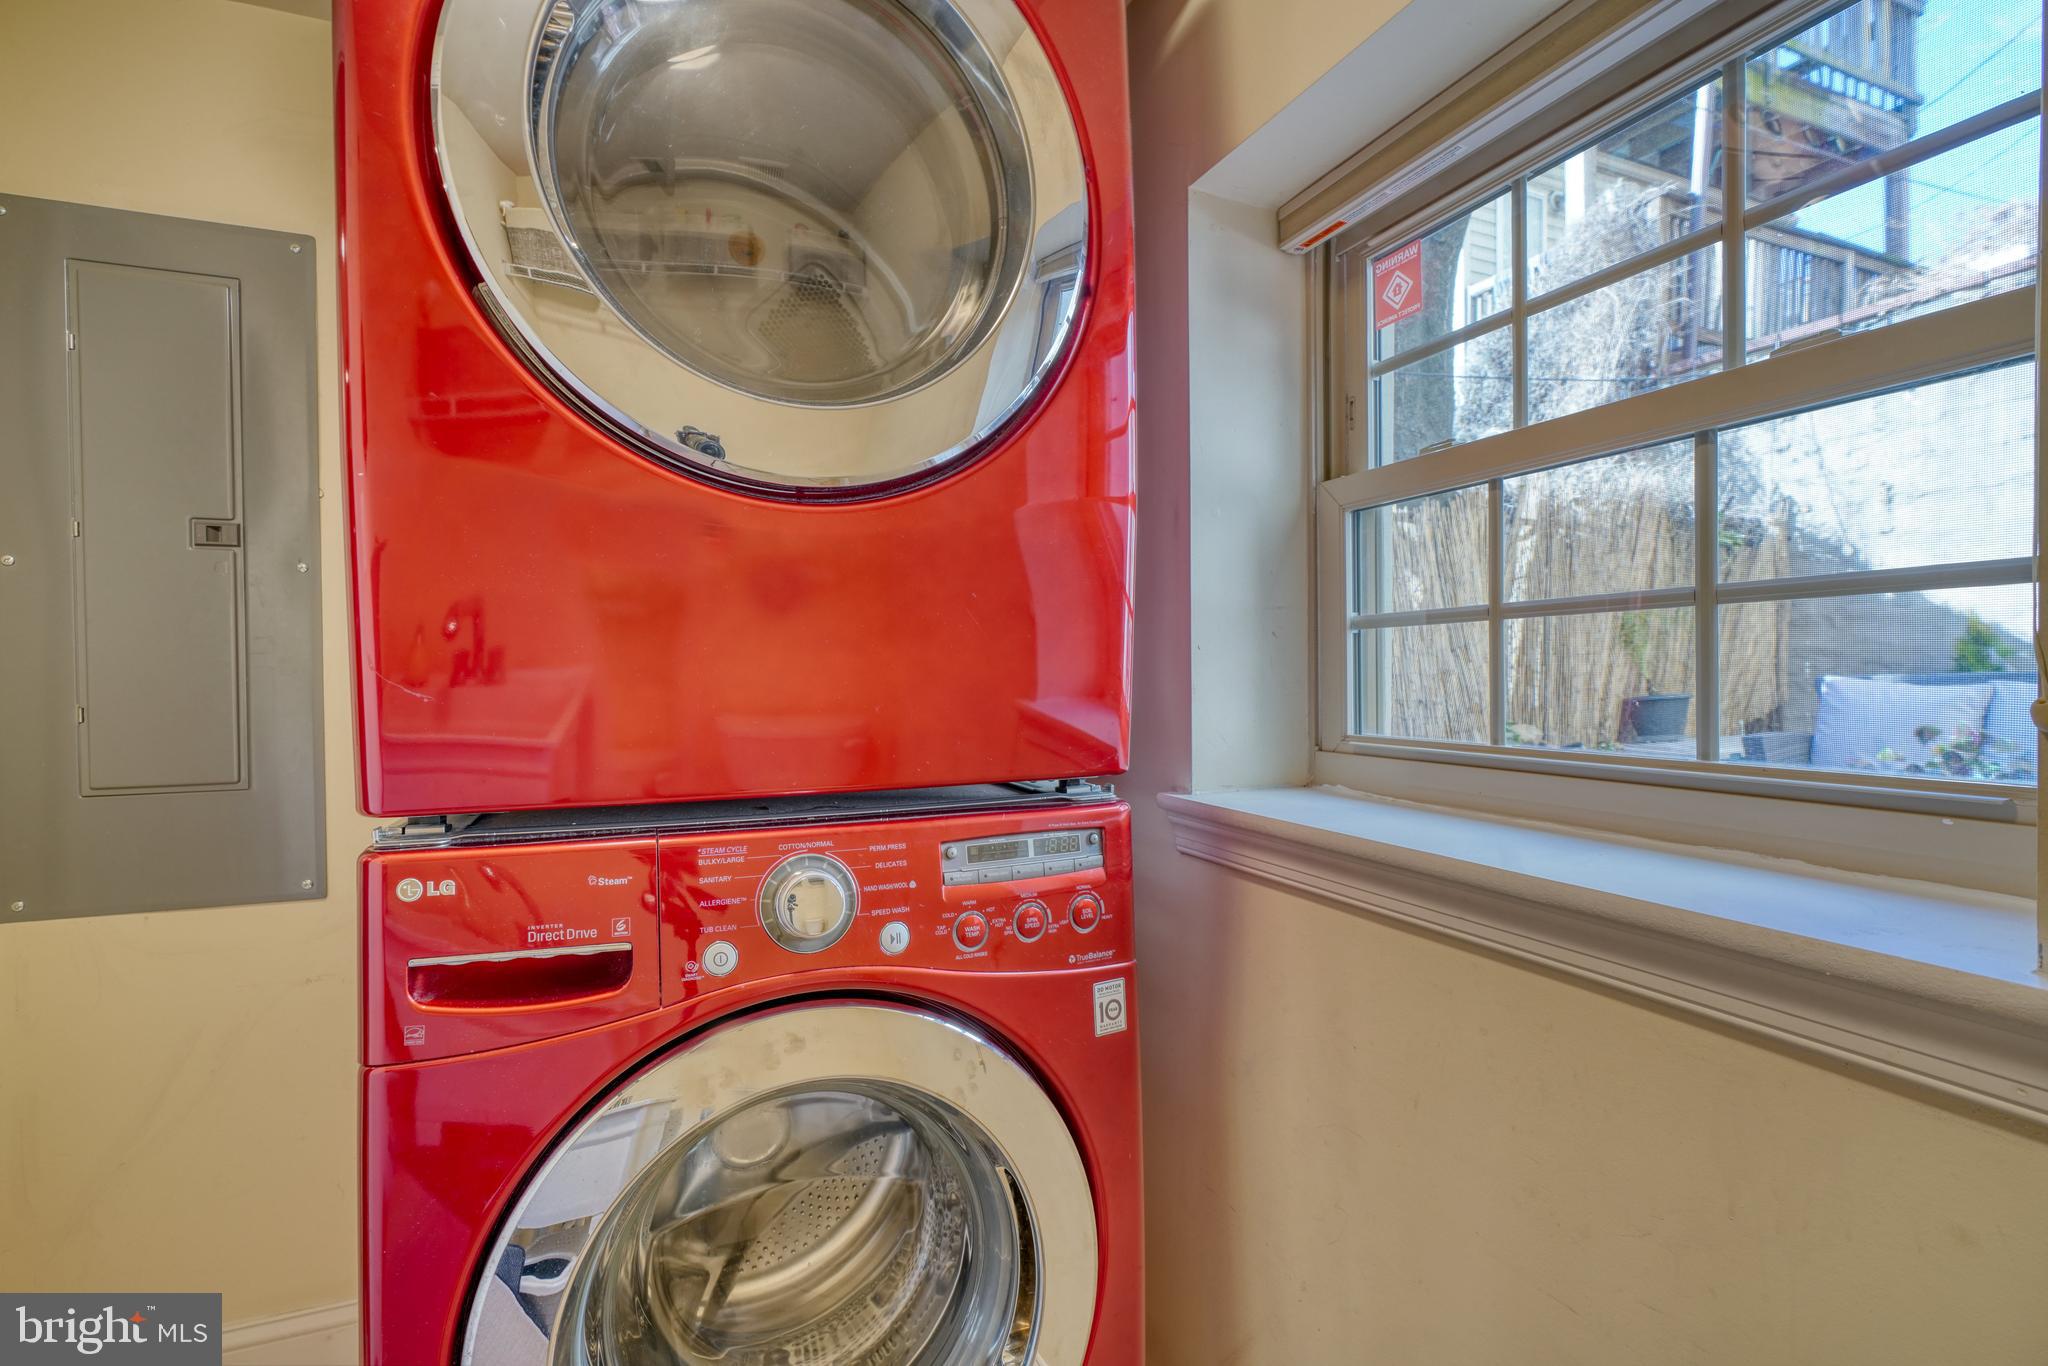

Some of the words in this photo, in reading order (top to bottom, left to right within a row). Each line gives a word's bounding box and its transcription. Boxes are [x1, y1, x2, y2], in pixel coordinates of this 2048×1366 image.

[726, 846, 748, 854] CYCLE
[778, 840, 834, 850] COTTON/NORMAL
[887, 843, 907, 851] PRESS
[698, 856, 745, 866] BULKY/LARGE
[875, 860, 907, 869] DELICATES
[699, 875, 732, 885] SANITARY
[426, 879, 456, 897] LG
[863, 884, 878, 892] HAND
[871, 908, 890, 917] SPEED
[891, 906, 910, 914] WASH
[699, 926, 714, 934] TUB
[715, 924, 737, 933] CLEAN
[527, 929, 565, 943] Direct
[566, 928, 598, 940] Drive
[1105, 983, 1121, 992] MOTOR
[1099, 999, 1122, 1024] 10
